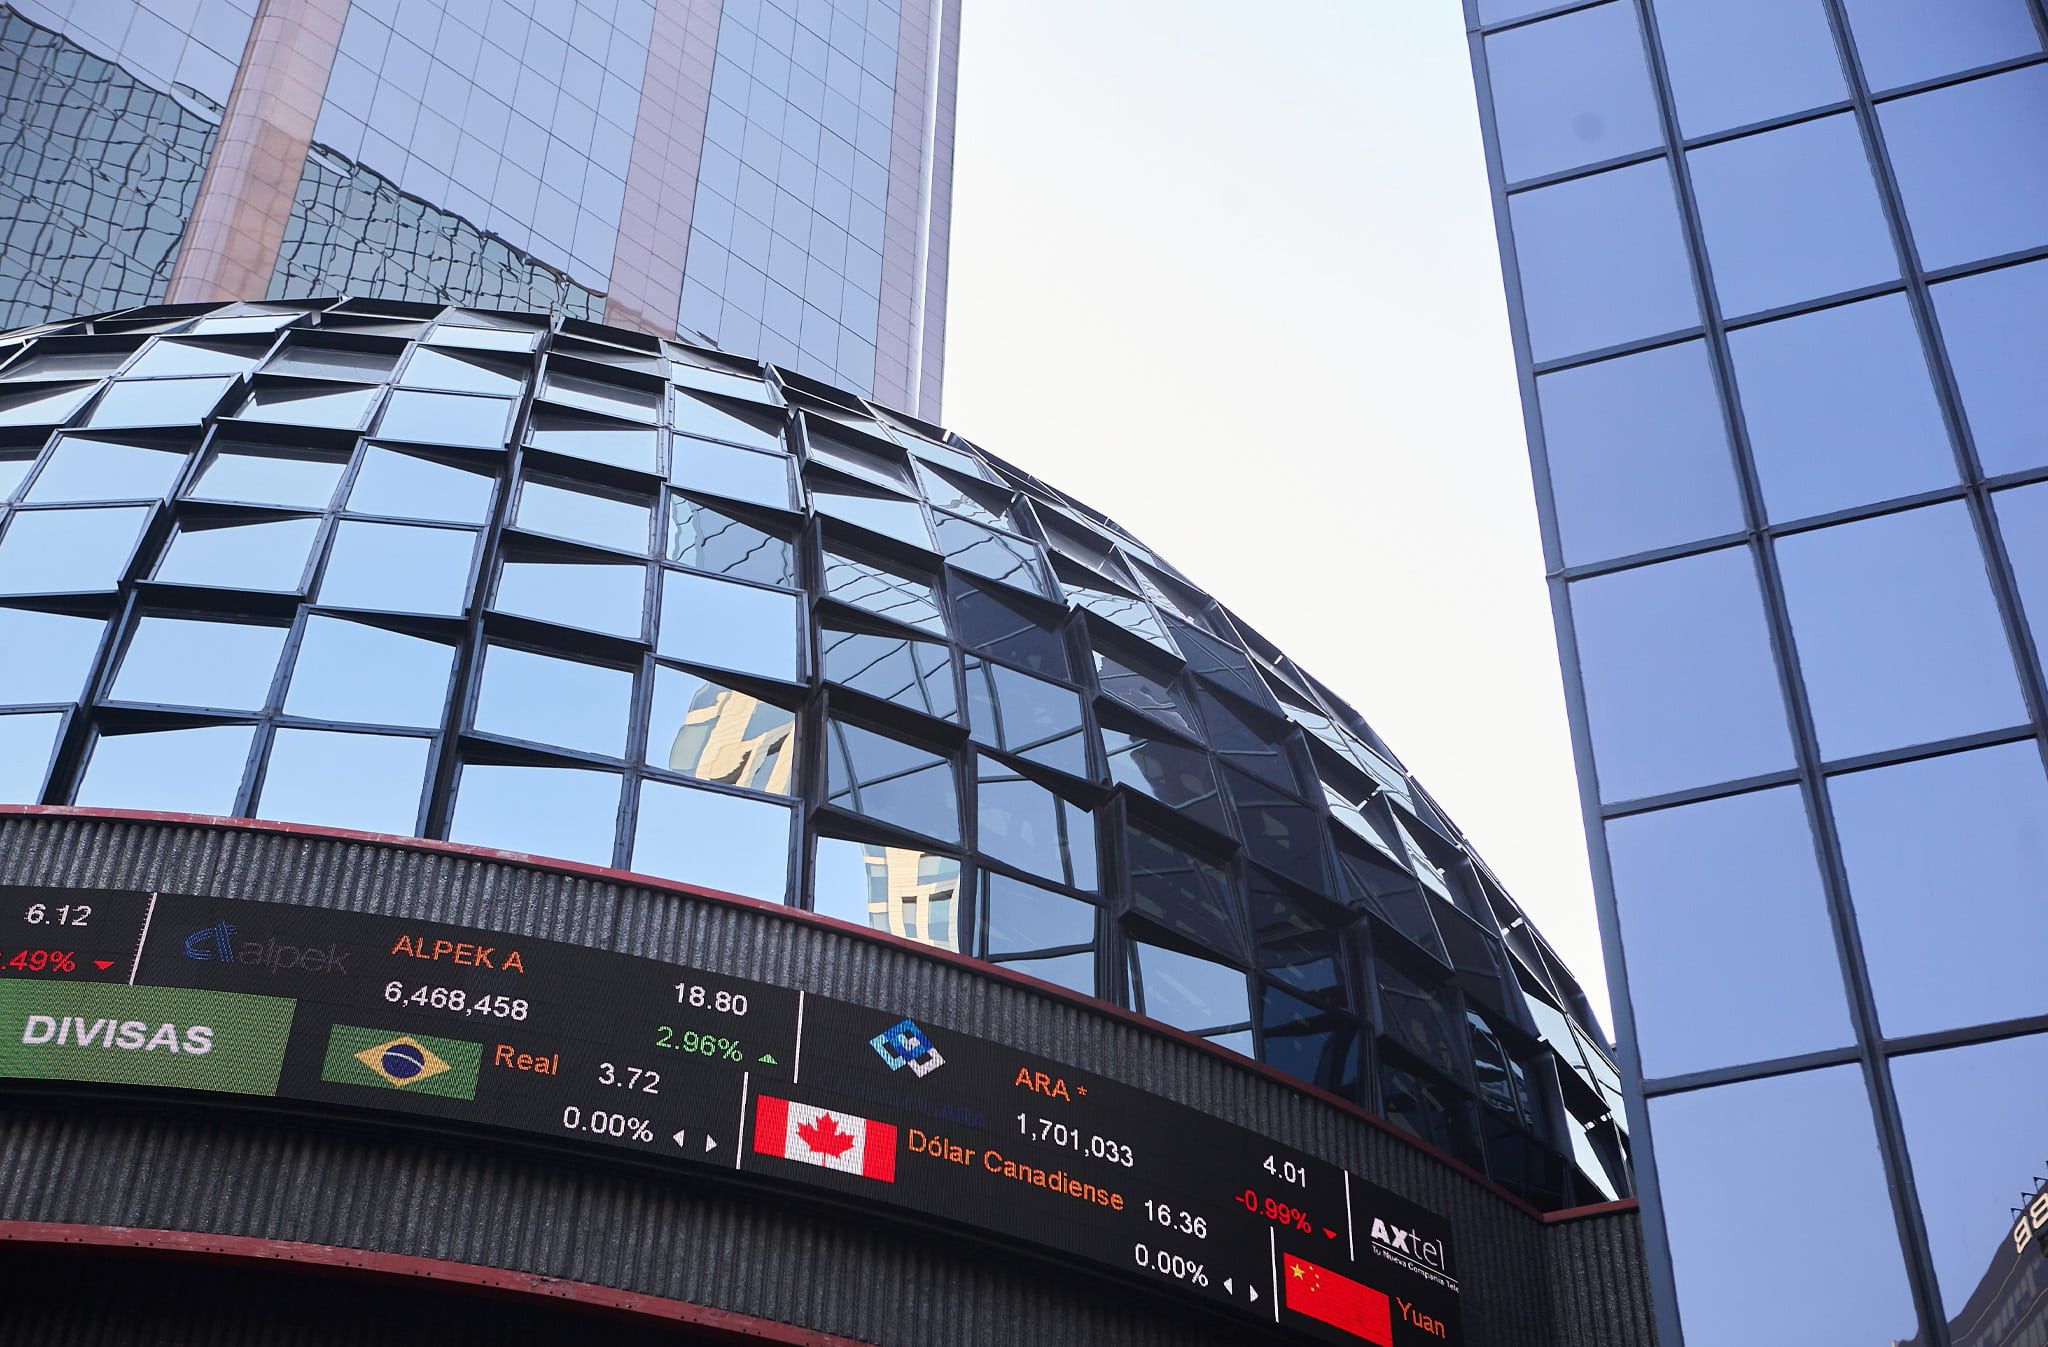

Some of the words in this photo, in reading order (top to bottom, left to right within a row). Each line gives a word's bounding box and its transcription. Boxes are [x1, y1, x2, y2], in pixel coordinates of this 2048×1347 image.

[24, 903, 92, 926] 6.12
[0, 948, 76, 973] .49%
[236, 936, 350, 975] alpek
[391, 934, 496, 969] ALPEK
[501, 951, 524, 974] A
[384, 980, 529, 1021] 6,468,458
[673, 982, 748, 1016] 18.80
[22, 1015, 214, 1055] DIVISAS
[655, 1025, 743, 1062] 2.96%
[494, 1043, 559, 1076] Real
[598, 1062, 661, 1094] 3.72
[1015, 1067, 1071, 1102] ARA
[562, 1106, 654, 1143] 0.00%
[1016, 1112, 1134, 1168] 1,701,033
[908, 1128, 975, 1166] Dólar
[984, 1150, 1124, 1211] Canadiense
[1263, 1155, 1306, 1188] 4.01
[1144, 1200, 1207, 1239] 16.36
[1235, 1190, 1312, 1234] -0.99%
[1135, 1244, 1209, 1288] 0.00%
[1396, 1297, 1446, 1339] Yuan
